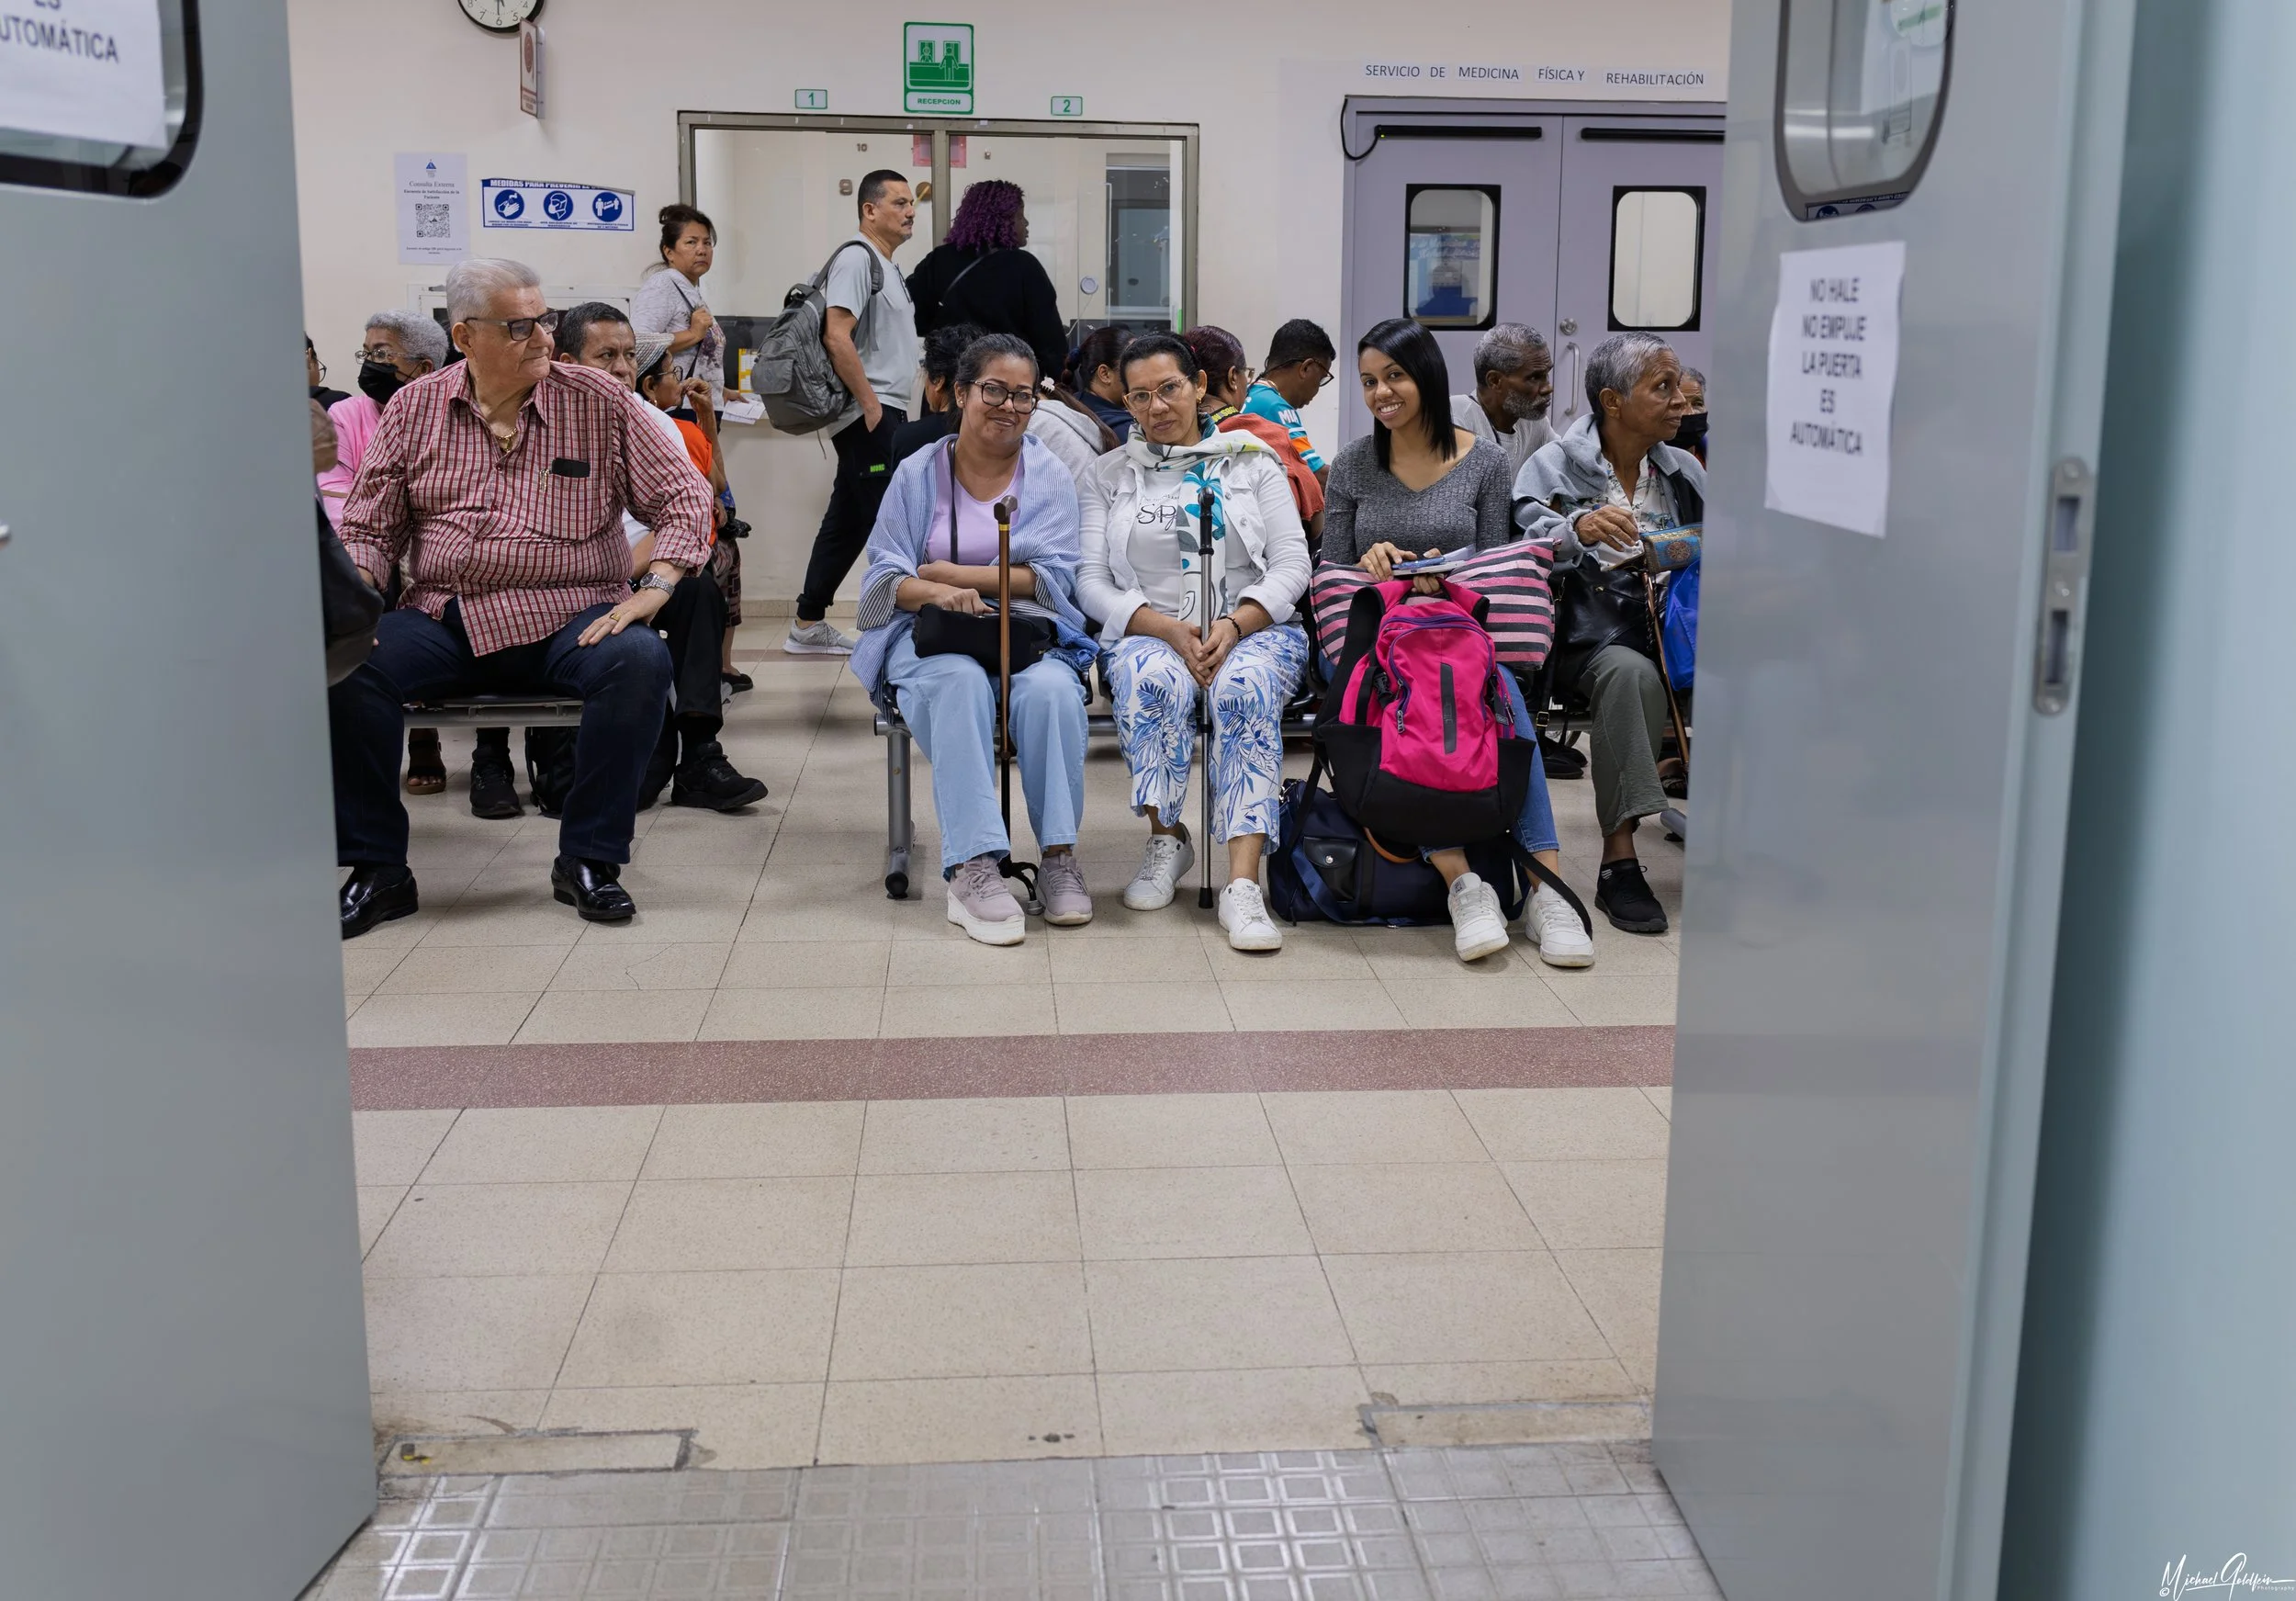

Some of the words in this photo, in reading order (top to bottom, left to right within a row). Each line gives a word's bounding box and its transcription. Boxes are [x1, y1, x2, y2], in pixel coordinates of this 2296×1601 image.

[479, 11, 486, 20] 7
[496, 17, 502, 27] 6
[512, 12, 519, 22] 5
[0, 14, 120, 63] UTOMÁTICA
[1366, 64, 1421, 78] SERVICIO
[1430, 66, 1446, 78] DE
[1458, 66, 1519, 80] MEDICINA
[1538, 65, 1574, 81] FÍSICA
[1577, 70, 1585, 82] Y
[1606, 71, 1705, 85] REHABILITACIÓN
[807, 92, 816, 107] 1
[917, 97, 962, 106] RECEPCION
[1063, 99, 1072, 113] 2
[856, 142, 868, 152] 10
[490, 179, 524, 188] MEDIDAS
[1809, 277, 1827, 303] NO
[1828, 277, 1861, 304] HALE
[1802, 314, 1818, 340] NO
[1820, 314, 1867, 343] EMPUJE
[1802, 351, 1818, 376] LA
[1818, 351, 1863, 380] PUERTA
[1819, 388, 1836, 414] ES
